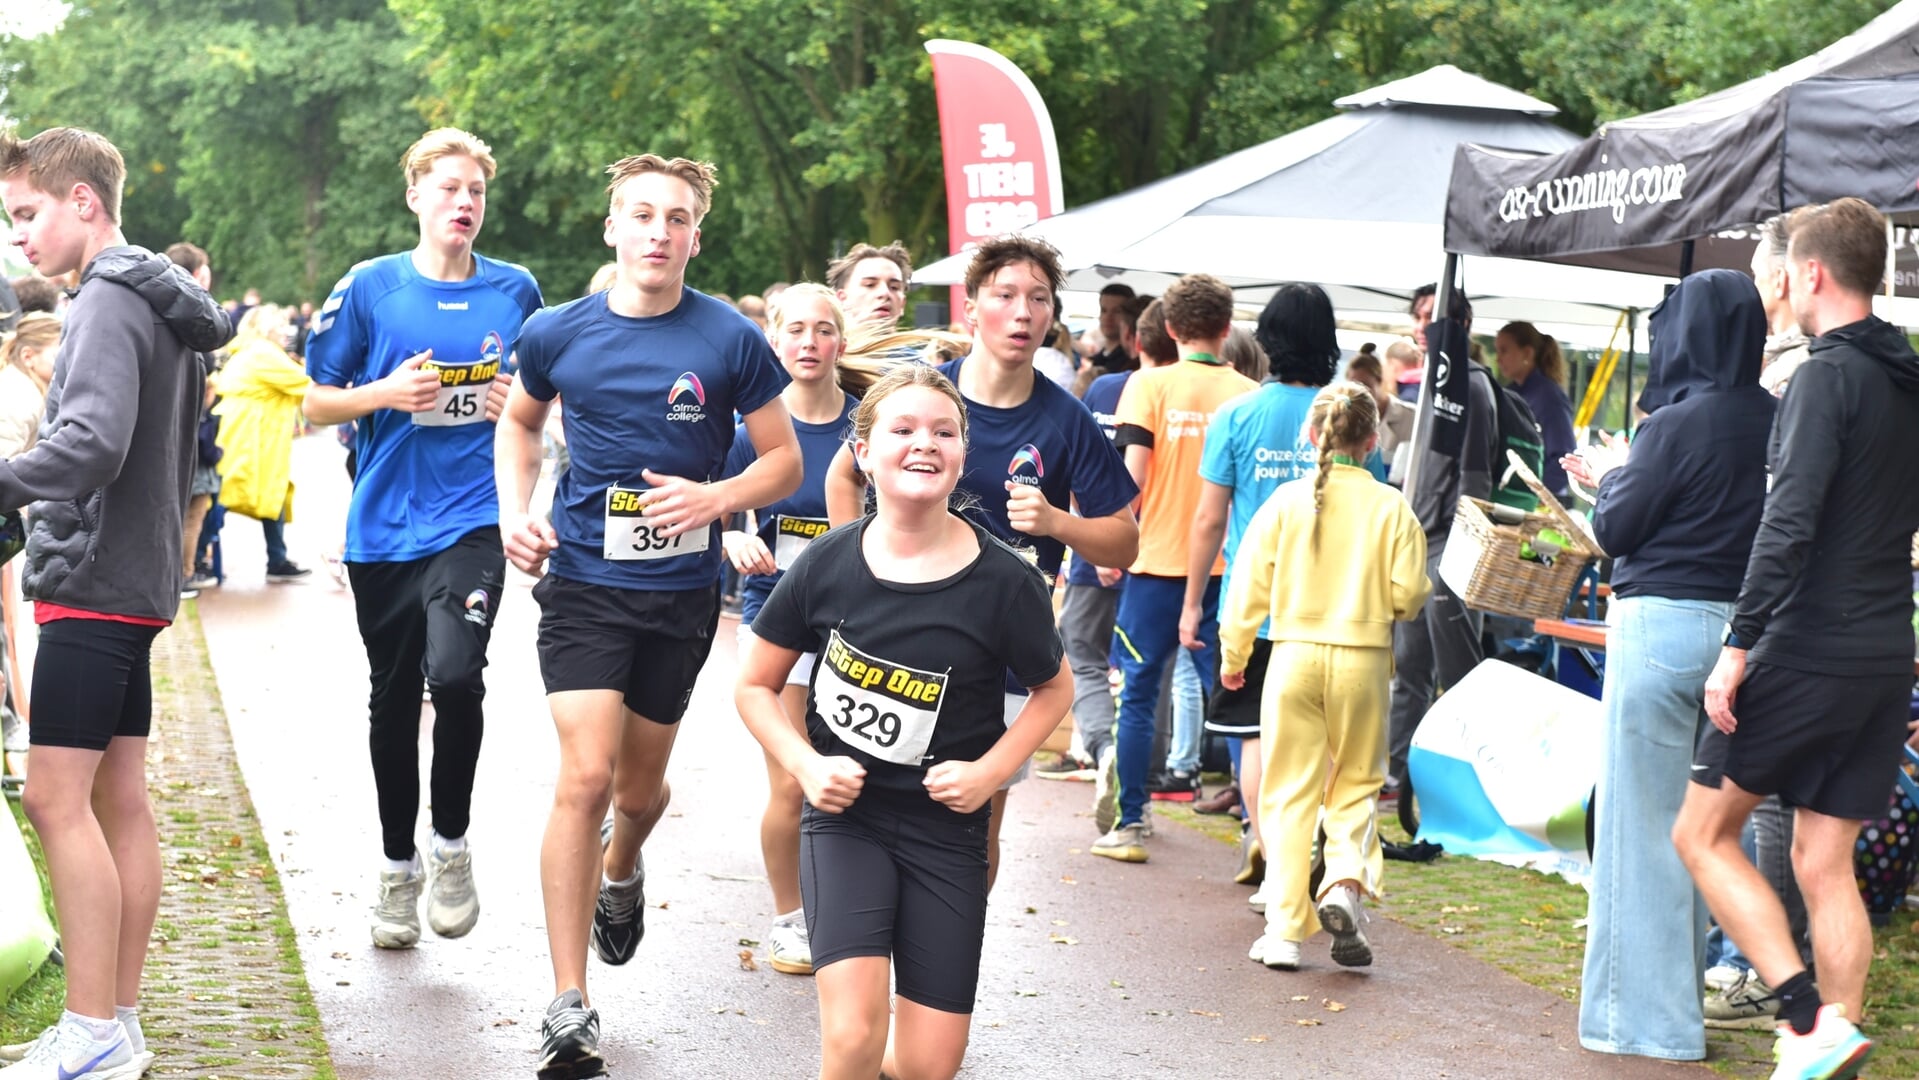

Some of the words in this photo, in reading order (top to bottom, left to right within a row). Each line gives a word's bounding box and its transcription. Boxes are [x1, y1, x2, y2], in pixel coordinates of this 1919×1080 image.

[1499, 154, 1687, 224] on-running.com
[444, 393, 477, 418] 45
[672, 403, 701, 412] alma
[666, 412, 706, 423] college
[1254, 447, 1293, 463] Onze
[1011, 474, 1039, 485] alma
[1254, 464, 1289, 482] jouw
[631, 523, 684, 552] 397
[780, 518, 828, 538] Step
[828, 639, 885, 689] Step
[886, 668, 942, 703] One
[832, 694, 902, 748] 329
